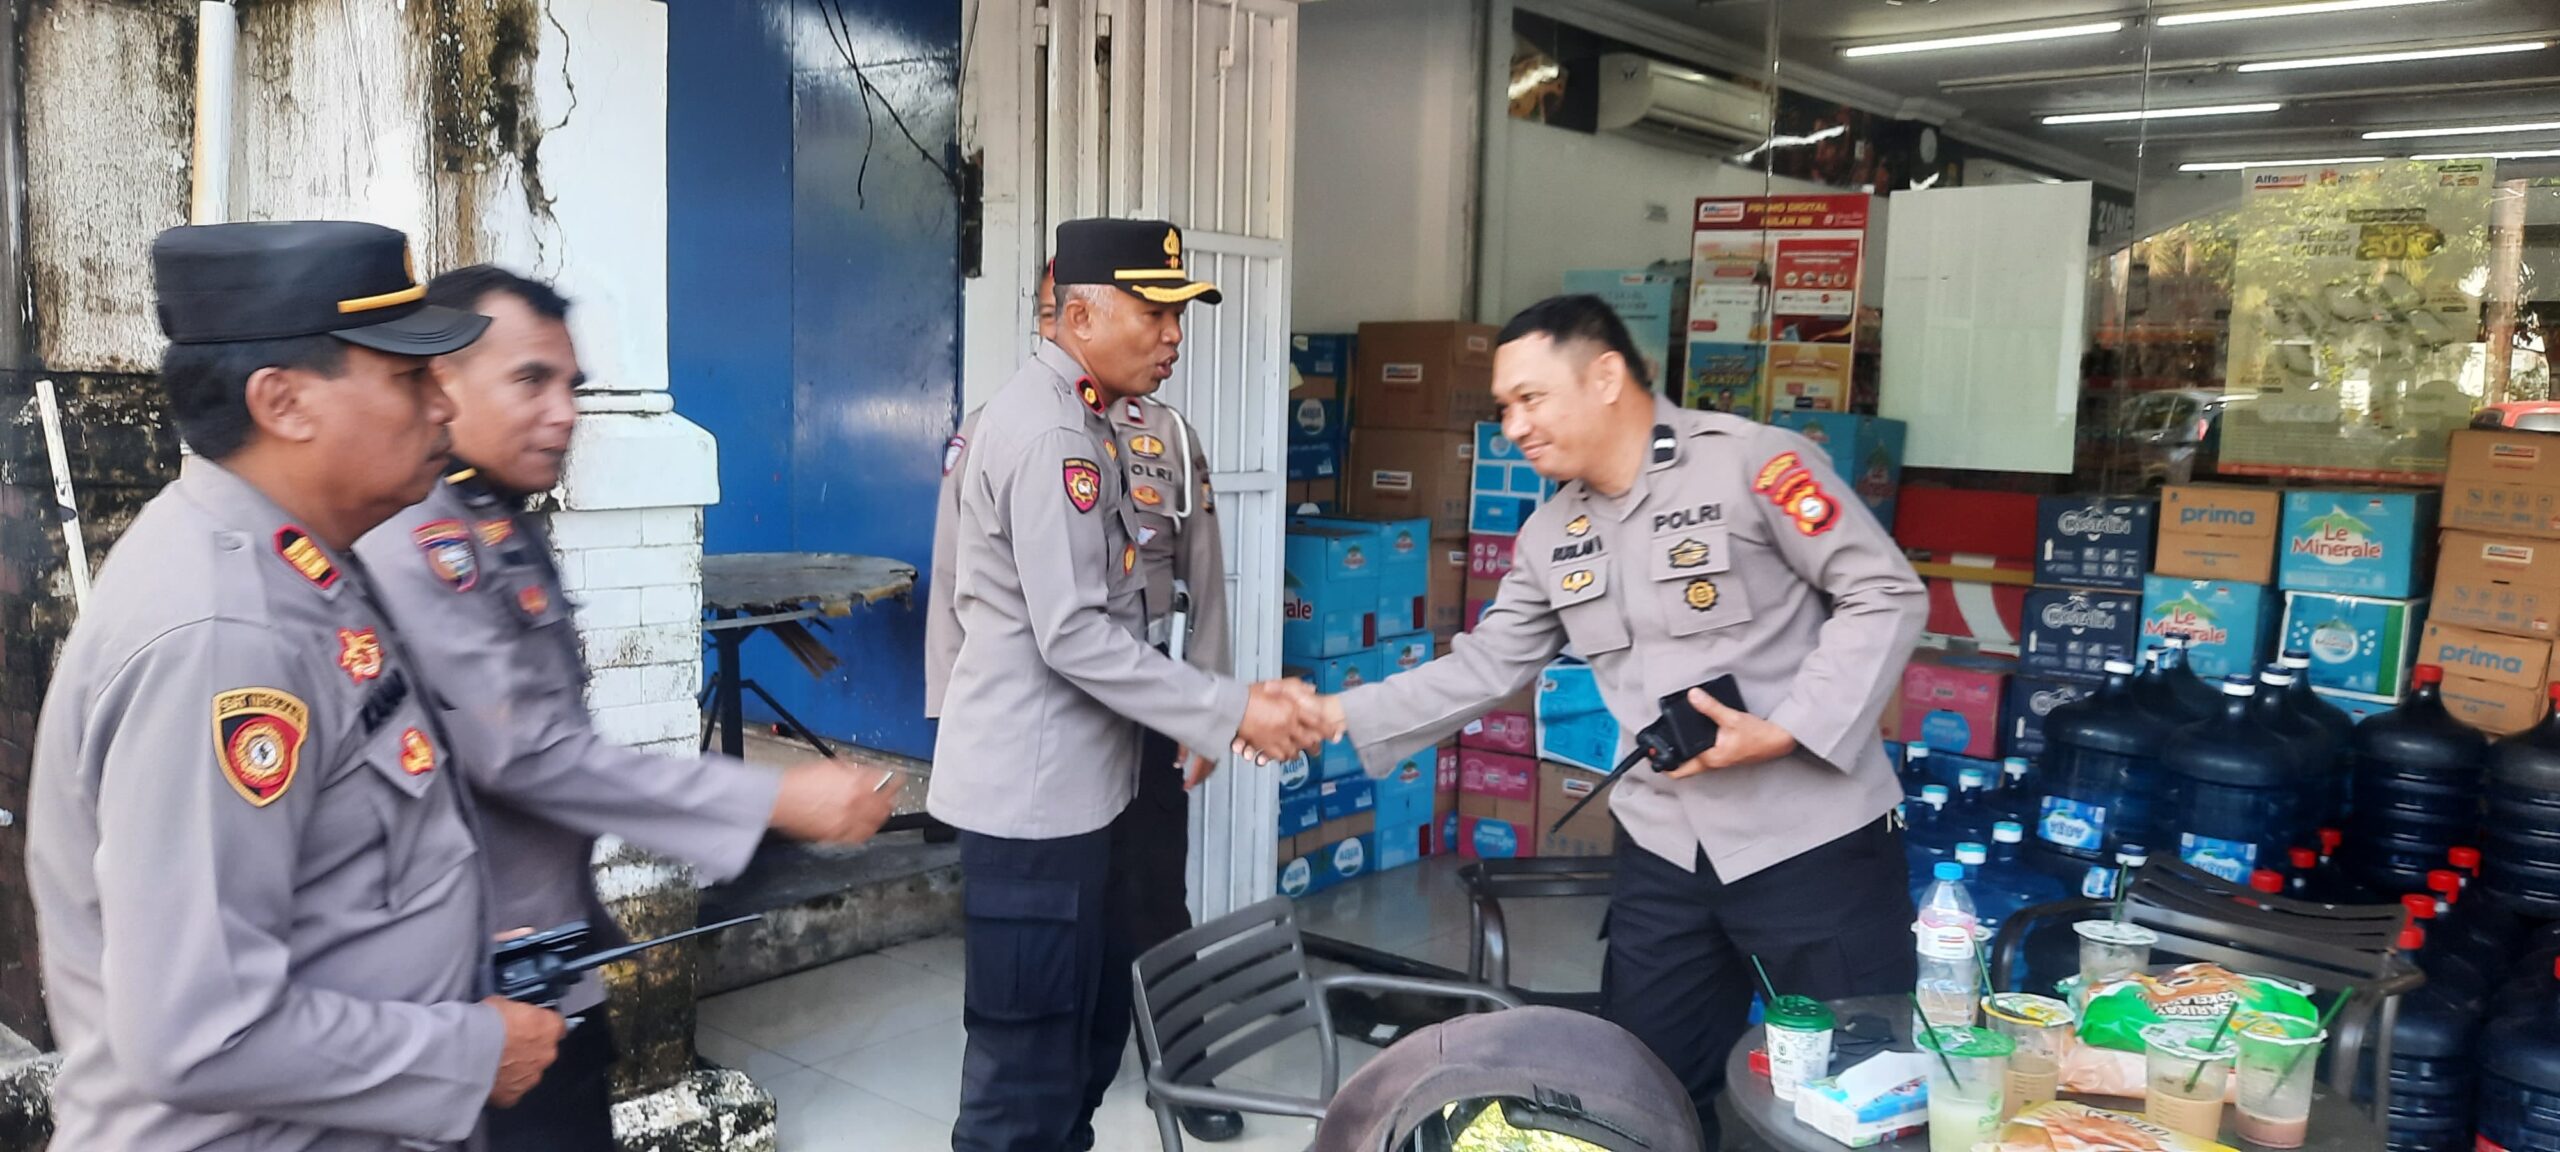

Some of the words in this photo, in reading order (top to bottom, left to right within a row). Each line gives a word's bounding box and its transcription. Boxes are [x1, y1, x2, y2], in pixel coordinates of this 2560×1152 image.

[2255, 174, 2307, 184] Alfamart
[1788, 201, 1828, 213] DIGITAL
[1131, 463, 1173, 481] OLRI
[1653, 503, 1721, 532] POLRI
[2181, 504, 2256, 525] prima
[2324, 522, 2348, 541] Le
[2292, 536, 2382, 559] Minerale
[2174, 608, 2196, 624] Le
[2438, 644, 2522, 674] prima
